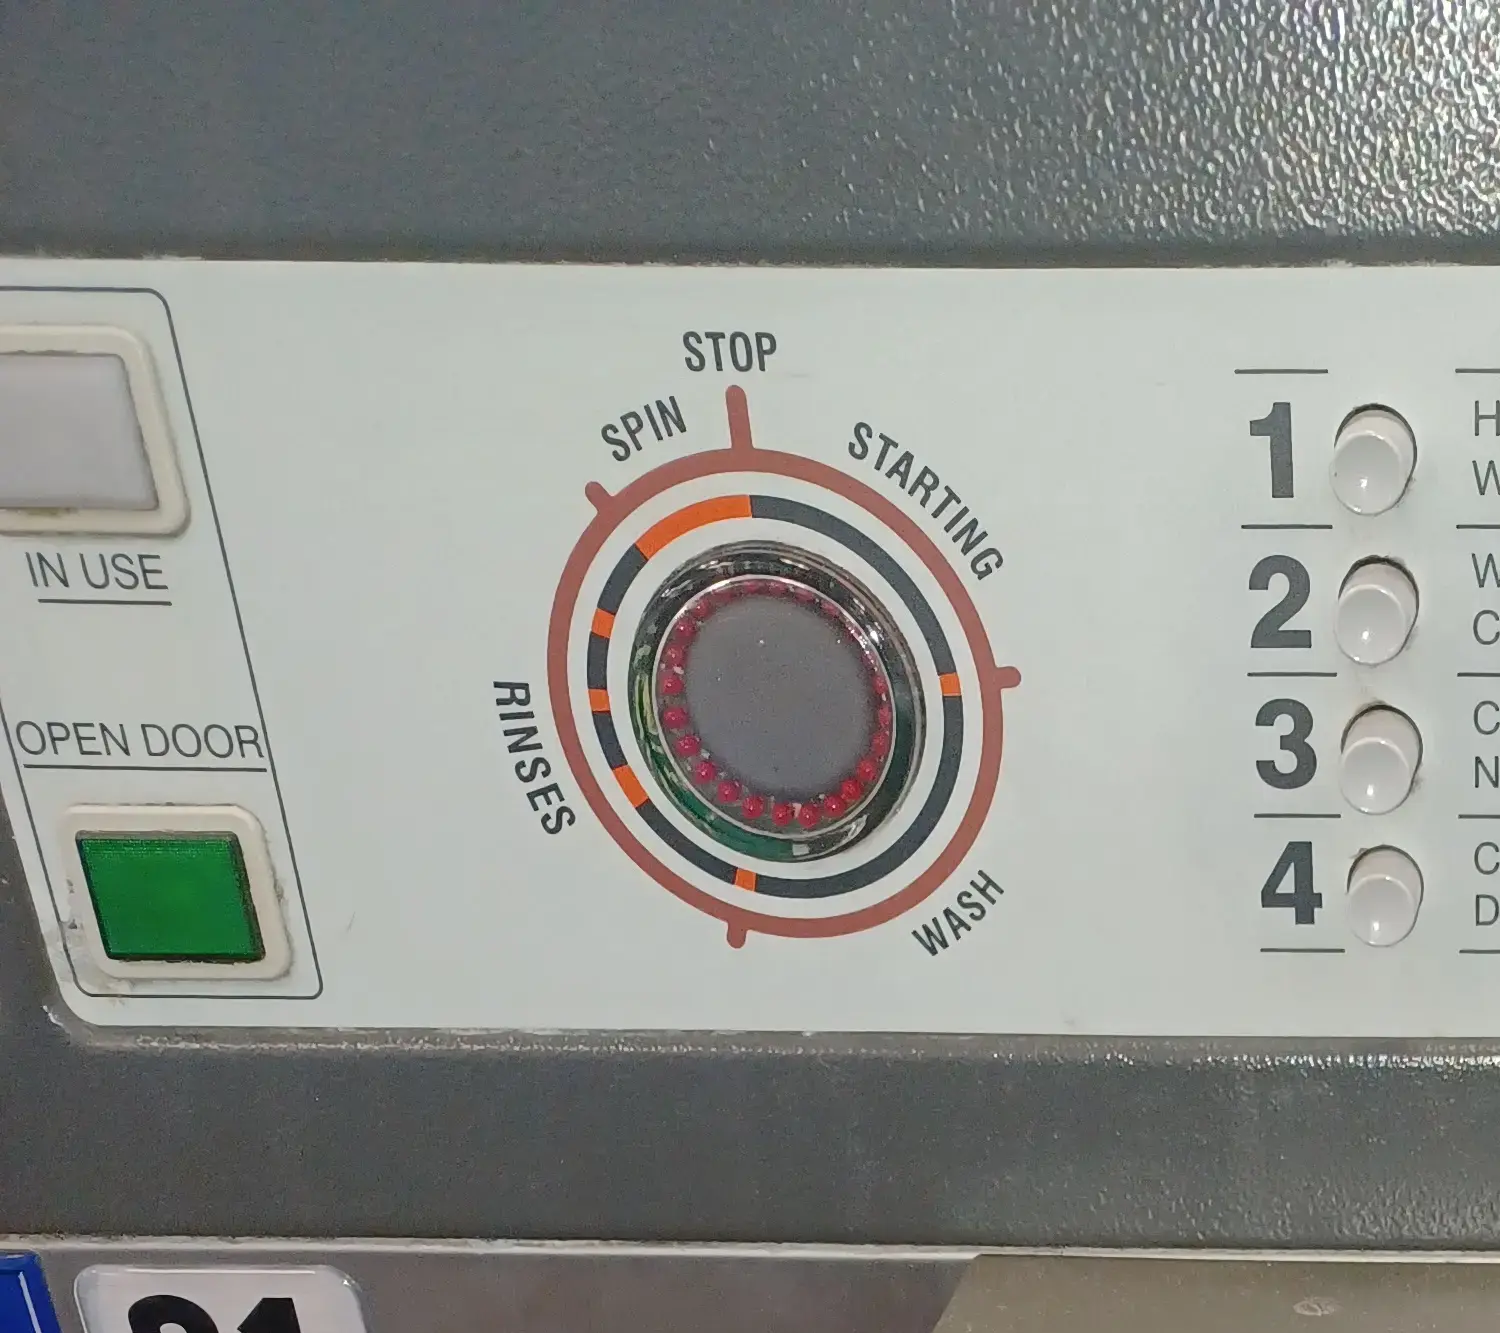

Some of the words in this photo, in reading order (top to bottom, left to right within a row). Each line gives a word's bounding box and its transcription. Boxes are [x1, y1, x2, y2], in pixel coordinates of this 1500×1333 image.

[682, 331, 777, 373] STOP
[601, 395, 688, 462] SPIN
[1249, 401, 1295, 499] 1
[847, 421, 1004, 581] STARTING
[25, 551, 70, 588] IN
[82, 552, 169, 591] USE
[1248, 554, 1313, 649] 2
[14, 720, 131, 759] OPEN
[141, 723, 264, 761] DOOR
[493, 680, 577, 836] RINSES
[1255, 698, 1318, 790] 3
[911, 868, 1005, 957] WASH
[1260, 840, 1323, 925] 4
